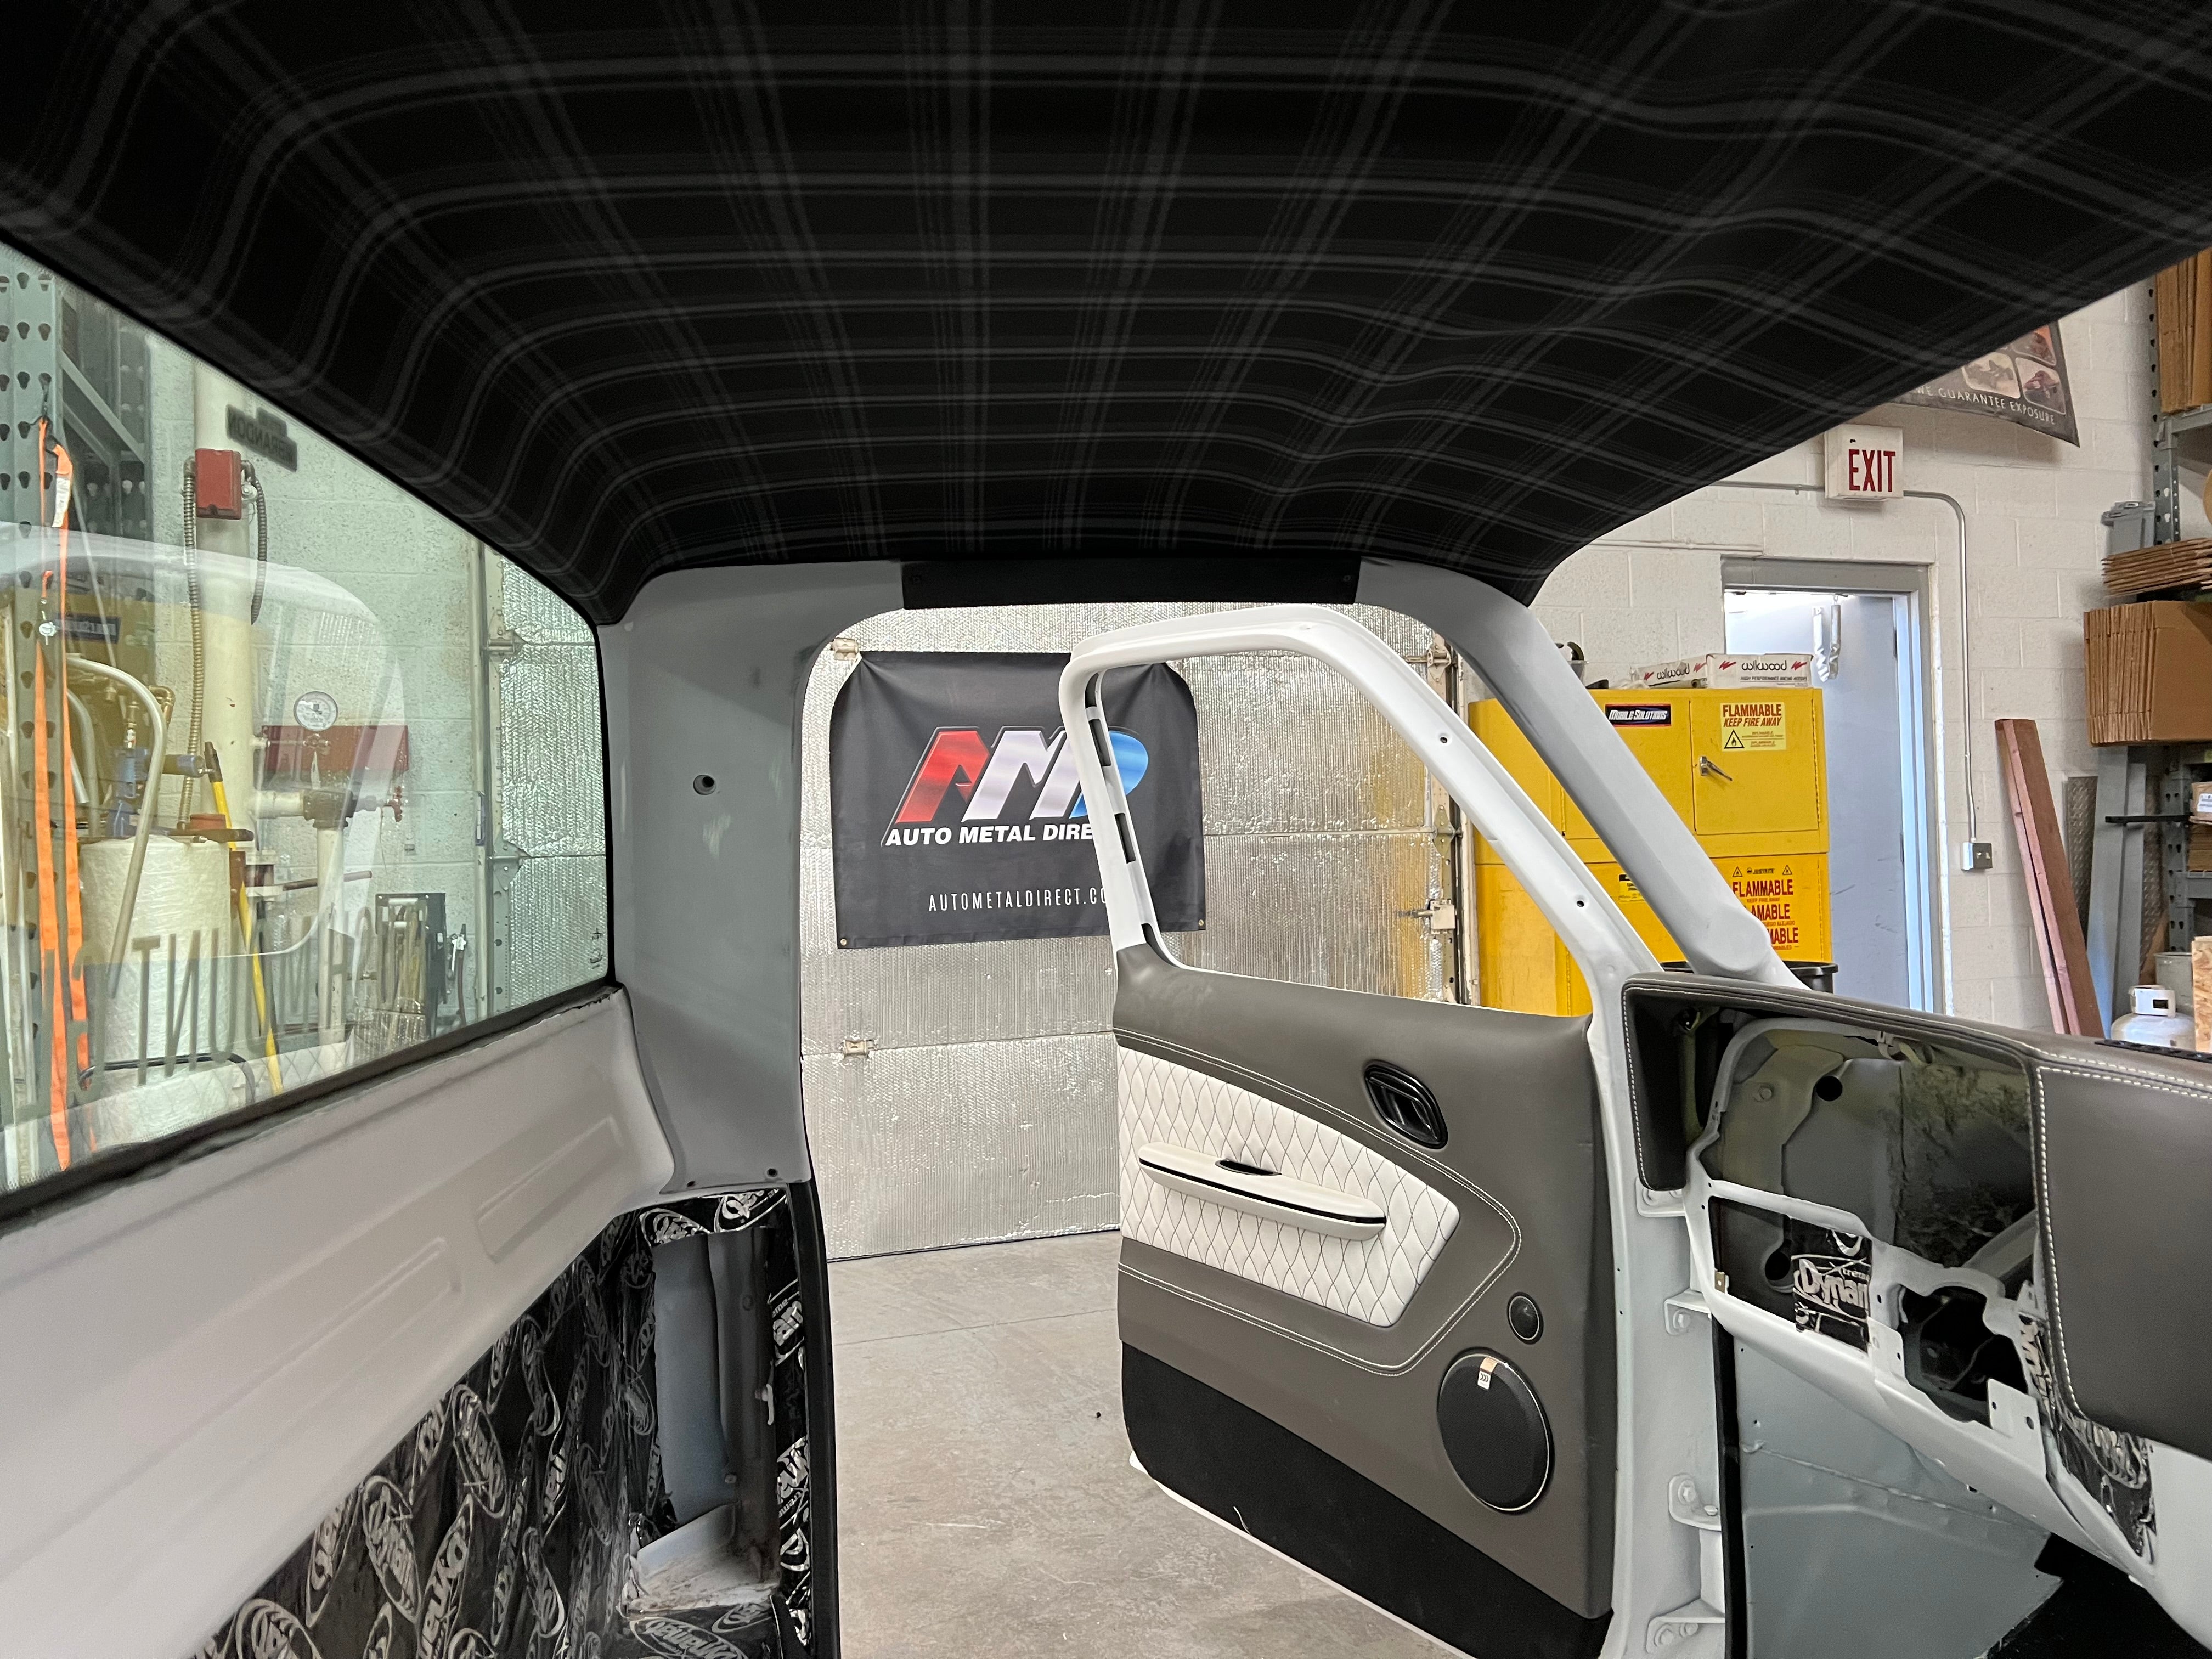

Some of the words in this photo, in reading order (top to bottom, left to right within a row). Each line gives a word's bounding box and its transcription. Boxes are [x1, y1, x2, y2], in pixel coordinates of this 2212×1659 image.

[1916, 386, 1933, 396] WE
[1938, 387, 2006, 409] GUARANTEE
[2010, 401, 2056, 425] EXPOSURE
[1848, 449, 1896, 493] EXIT
[1741, 659, 1787, 671] wilwood
[1723, 704, 1782, 717] FLAMMABLE
[1723, 718, 1742, 727] KEEP
[1743, 717, 1760, 726] FIRE
[1760, 716, 1782, 726] AWAY
[885, 826, 952, 846] AUTO
[959, 824, 1036, 844] METAL
[1042, 823, 1094, 841] DIRE
[1733, 879, 1794, 898] FLAMMABLE
[929, 887, 1107, 912] AUTOMETALDIRECT.CO
[1751, 903, 1791, 921] AMABLE
